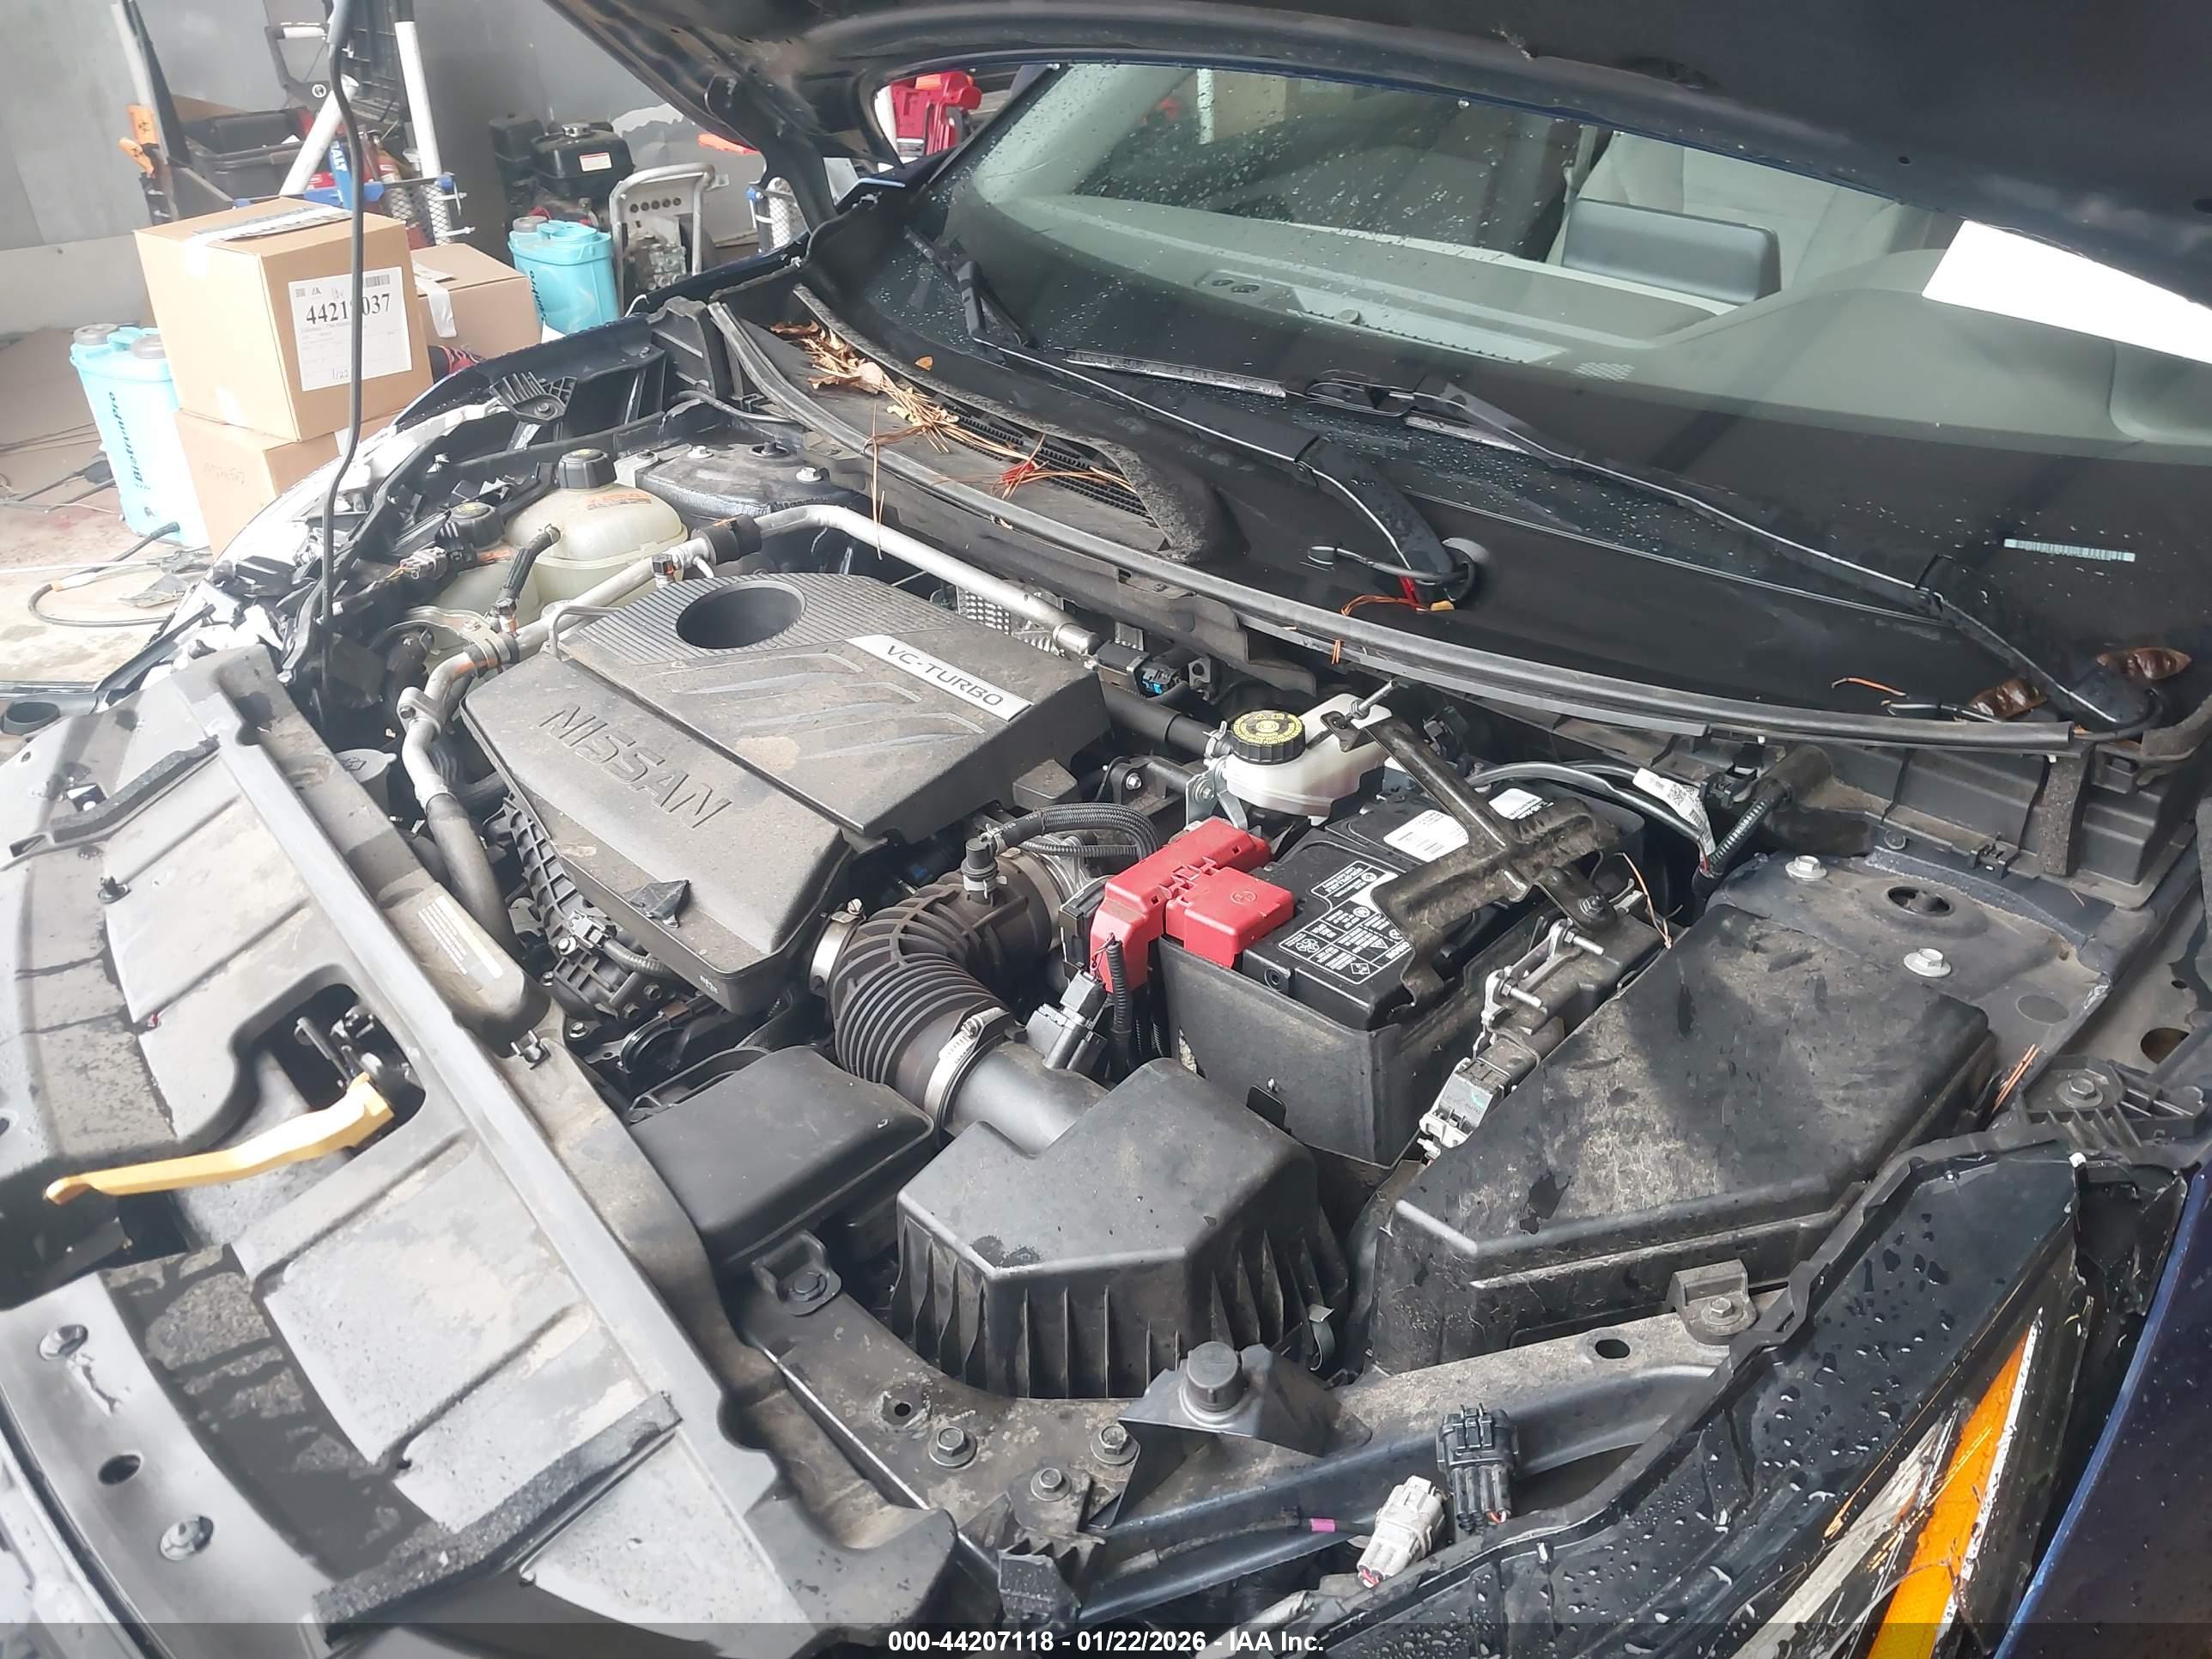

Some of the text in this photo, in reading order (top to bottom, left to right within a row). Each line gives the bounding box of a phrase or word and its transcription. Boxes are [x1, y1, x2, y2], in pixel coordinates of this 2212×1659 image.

[307, 293, 390, 325] 4421037
[887, 645, 1004, 706] VC-TURBO
[538, 706, 732, 830] NISSAN
